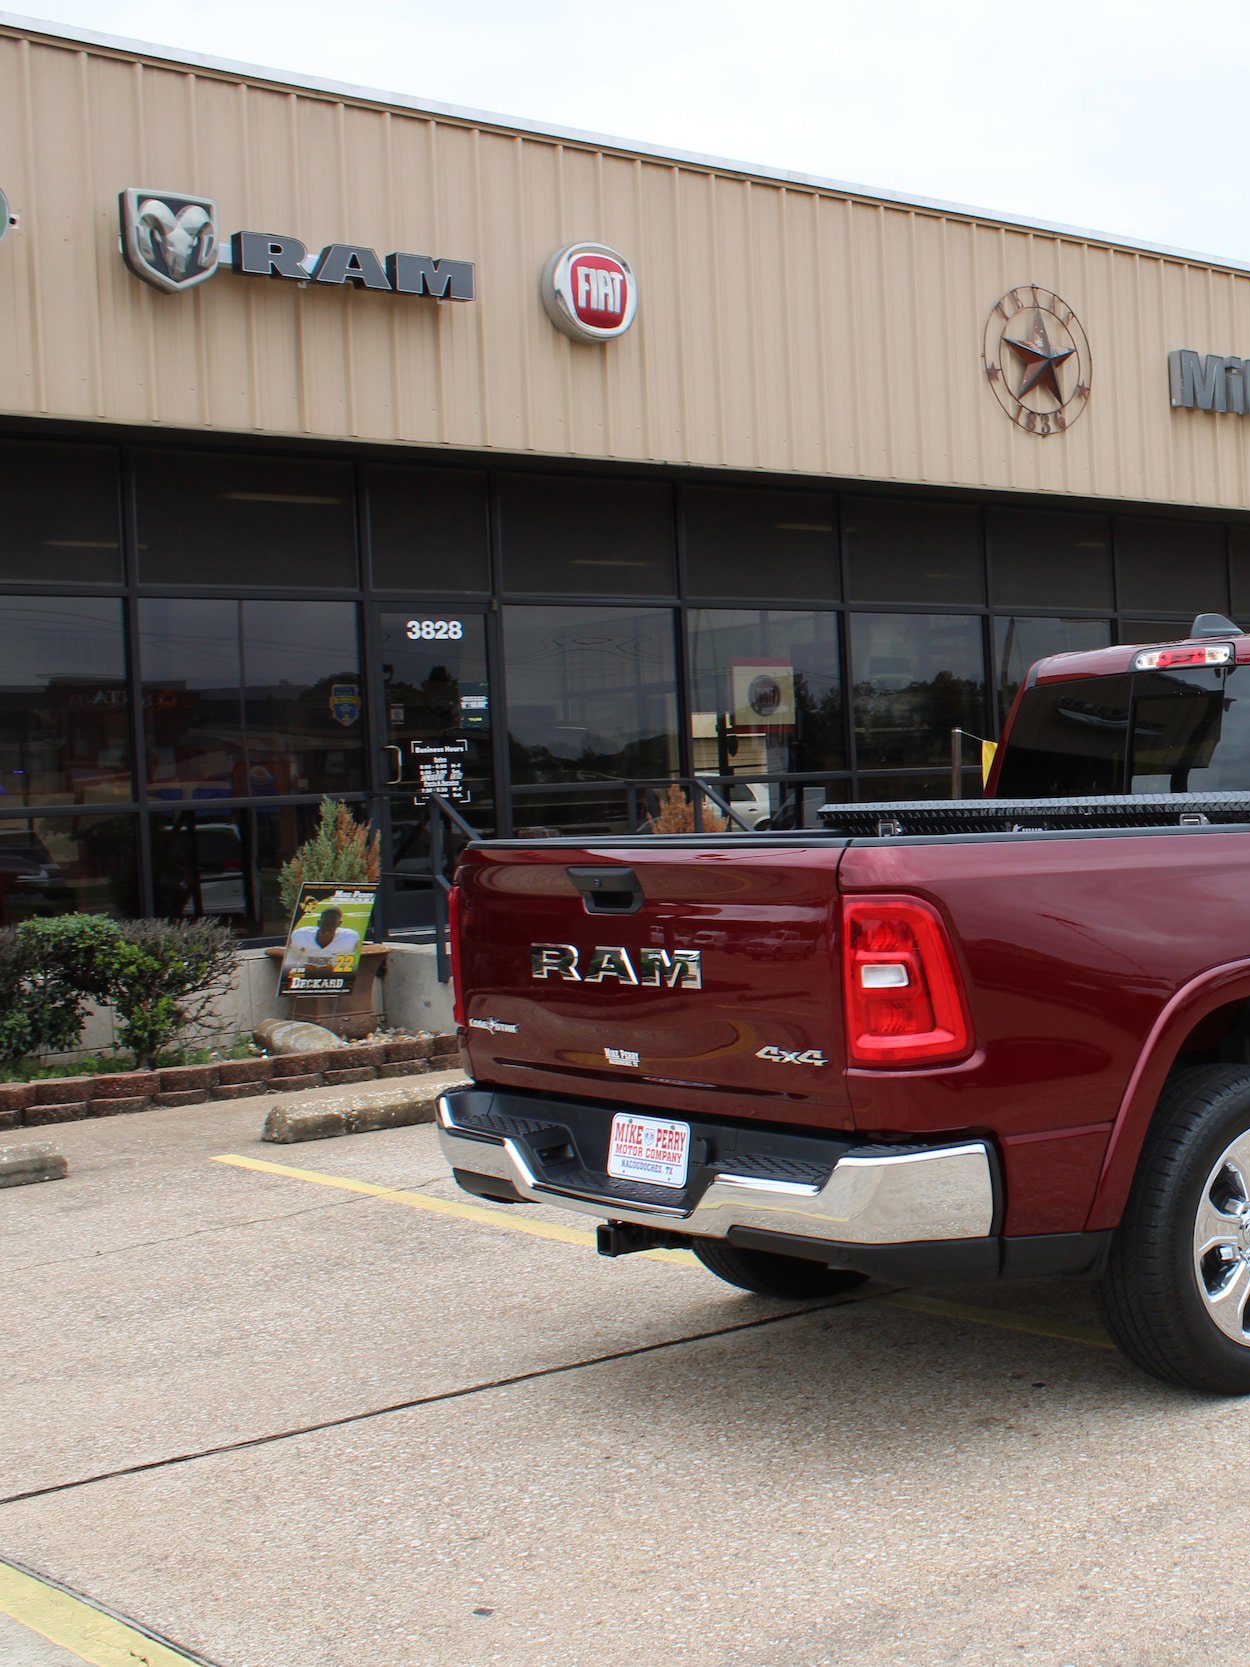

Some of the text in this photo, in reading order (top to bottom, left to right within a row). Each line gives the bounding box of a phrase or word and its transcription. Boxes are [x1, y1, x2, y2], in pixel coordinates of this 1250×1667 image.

[231, 231, 476, 302] RAM
[577, 265, 624, 314] FIAT
[995, 287, 1076, 327] TEXAS
[1014, 403, 1067, 434] 1836
[406, 620, 463, 640] 3828
[334, 954, 355, 973] 22
[531, 942, 702, 990] RAM
[289, 977, 344, 989] DECKARD
[615, 1122, 687, 1152] MIKE PERRY
[615, 1143, 683, 1163] MOTOR COMPANY
[665, 1166, 674, 1175] TX
